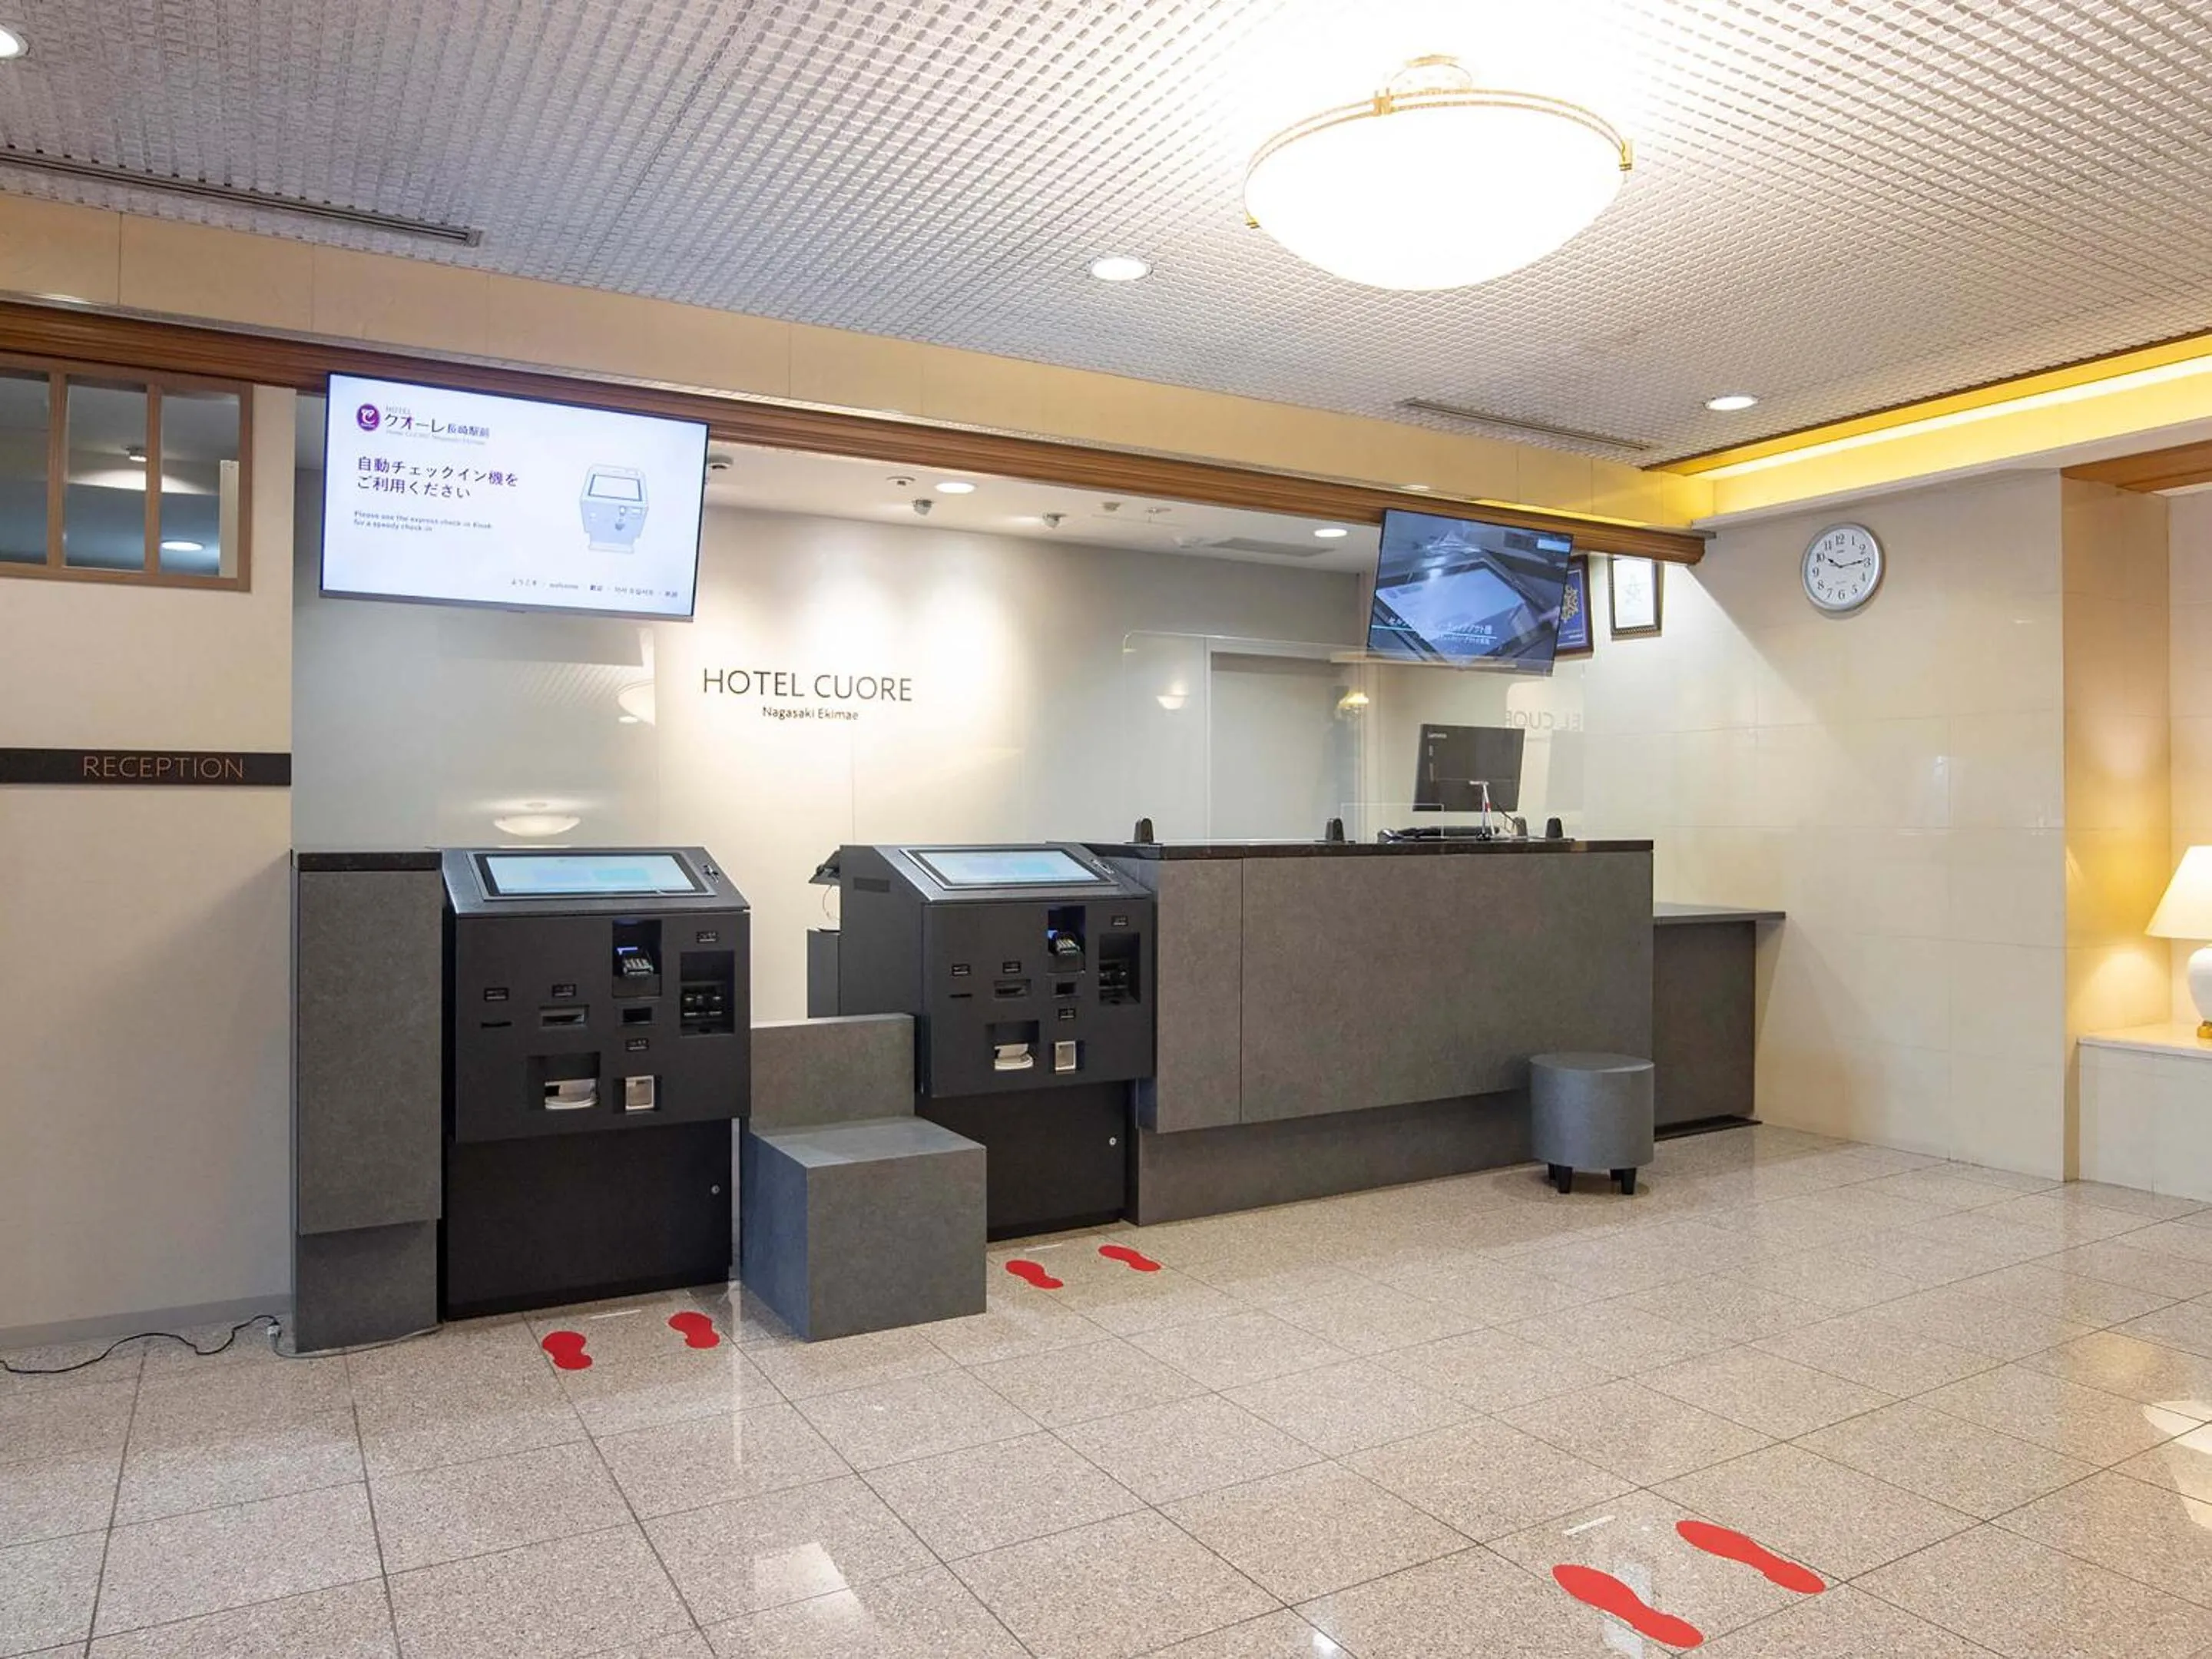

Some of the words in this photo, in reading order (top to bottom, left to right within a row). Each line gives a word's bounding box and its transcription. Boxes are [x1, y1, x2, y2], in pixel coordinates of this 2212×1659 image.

[358, 456, 518, 487] 自動チェックイン機を
[357, 475, 471, 498] ご利用ください
[1836, 534, 1845, 545] 12
[1851, 535, 1855, 545] 1
[1824, 540, 1832, 551] 11
[1859, 544, 1866, 555] 2
[1816, 553, 1825, 562] 10
[1863, 557, 1871, 568] 3
[1812, 567, 1820, 578] 9
[1817, 580, 1825, 590] 8
[1851, 584, 1858, 594] 5
[1827, 588, 1833, 598] 7
[1838, 589, 1846, 600] 6
[703, 667, 805, 697] HOTEL
[814, 674, 912, 702] CUORE
[763, 707, 816, 720] Nagasaki
[817, 708, 859, 721] Ekimae
[82, 755, 245, 780] RECEPTION
